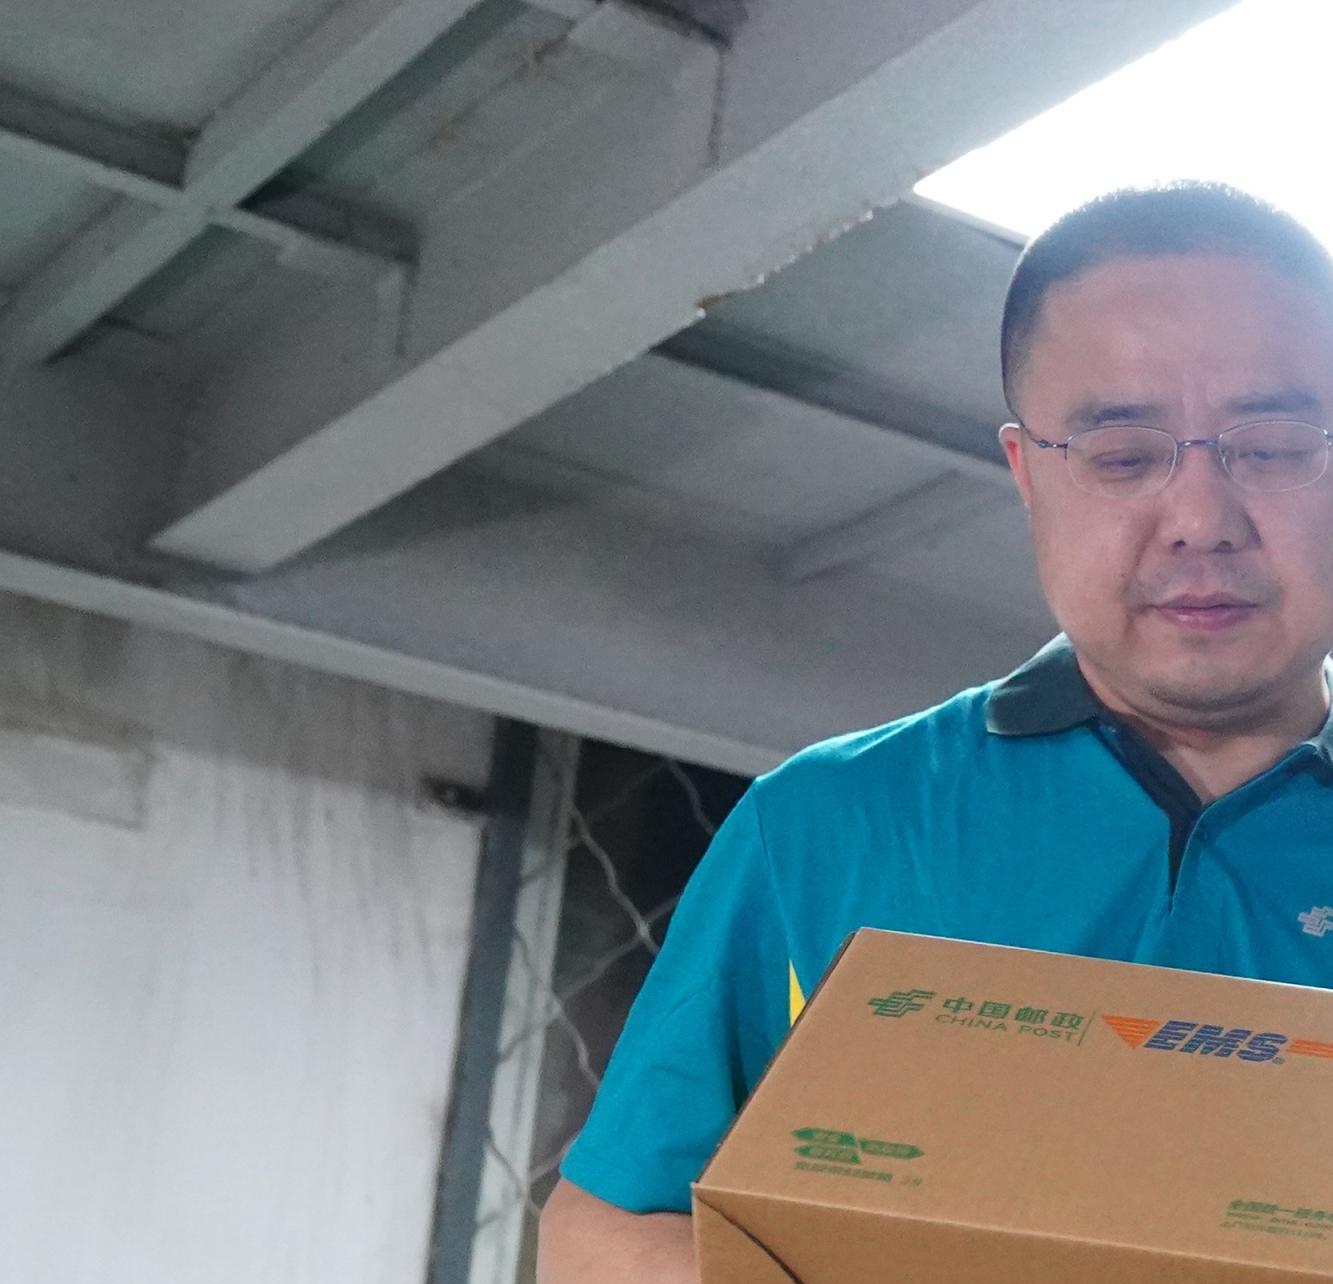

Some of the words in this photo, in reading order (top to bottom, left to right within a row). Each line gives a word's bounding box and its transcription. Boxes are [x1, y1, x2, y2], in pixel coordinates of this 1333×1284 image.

[934, 1013, 1009, 1033] CHINA
[1018, 1024, 1079, 1042] POST
[942, 996, 1086, 1030] 中国邮政
[1144, 1019, 1288, 1063] EMS
